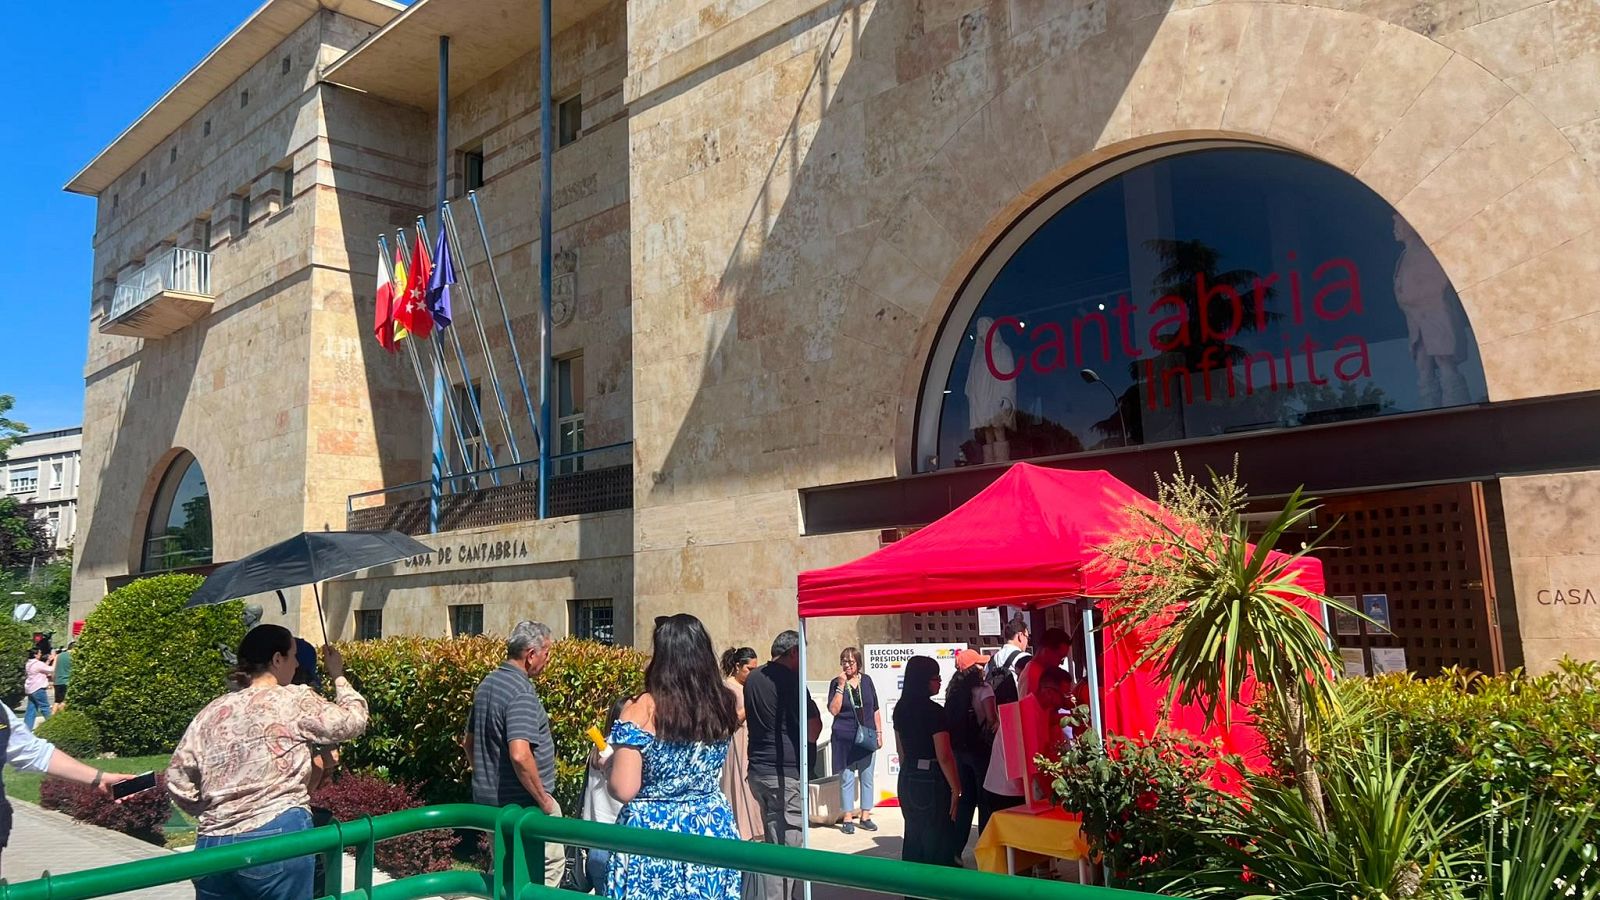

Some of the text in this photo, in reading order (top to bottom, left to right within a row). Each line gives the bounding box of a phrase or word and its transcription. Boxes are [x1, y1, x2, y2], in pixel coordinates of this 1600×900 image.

[984, 250, 1366, 382] Cantabria
[1145, 333, 1372, 411] Infinita
[438, 546, 453, 566] DE
[458, 538, 528, 564] CANTABRIA
[1536, 588, 1597, 606] CASA
[870, 648, 915, 656] ELECCIONES
